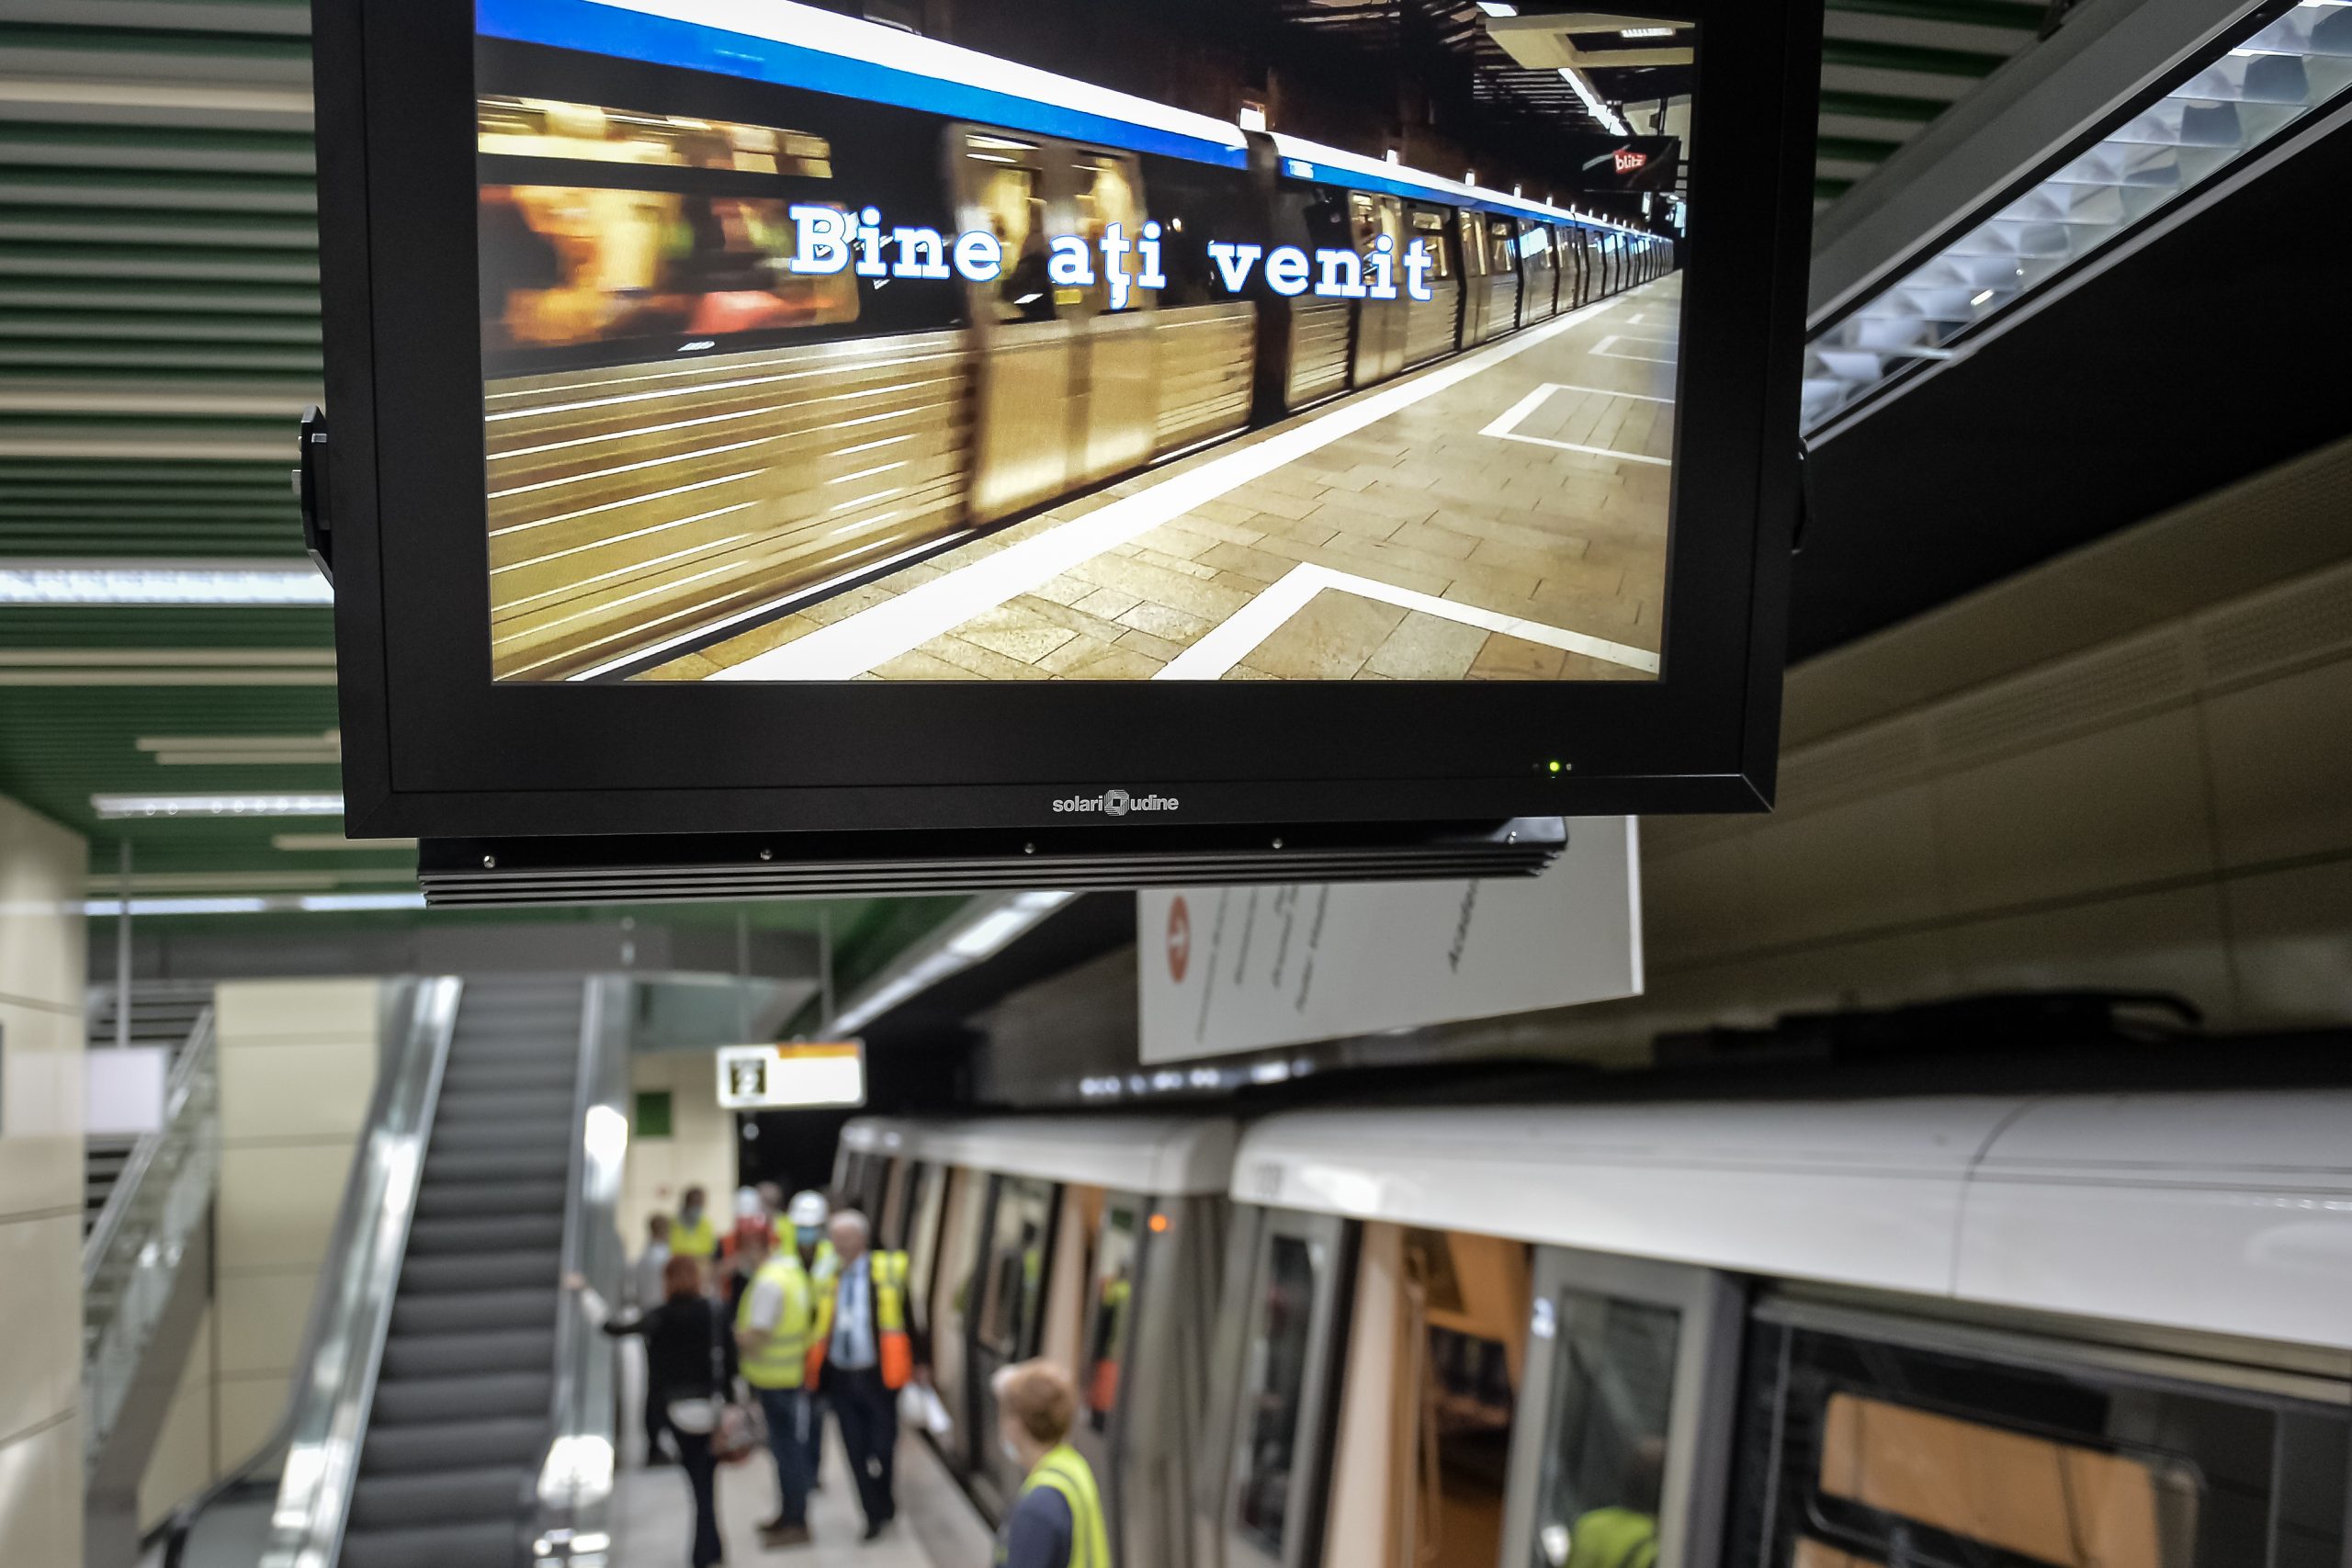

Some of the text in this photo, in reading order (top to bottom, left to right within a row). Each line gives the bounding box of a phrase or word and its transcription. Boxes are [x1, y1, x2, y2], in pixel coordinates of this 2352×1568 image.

[1615, 154, 1644, 171] blitz
[789, 203, 1002, 281] Bine
[1208, 234, 1433, 301] venit
[1052, 794, 1179, 812] solari udine
